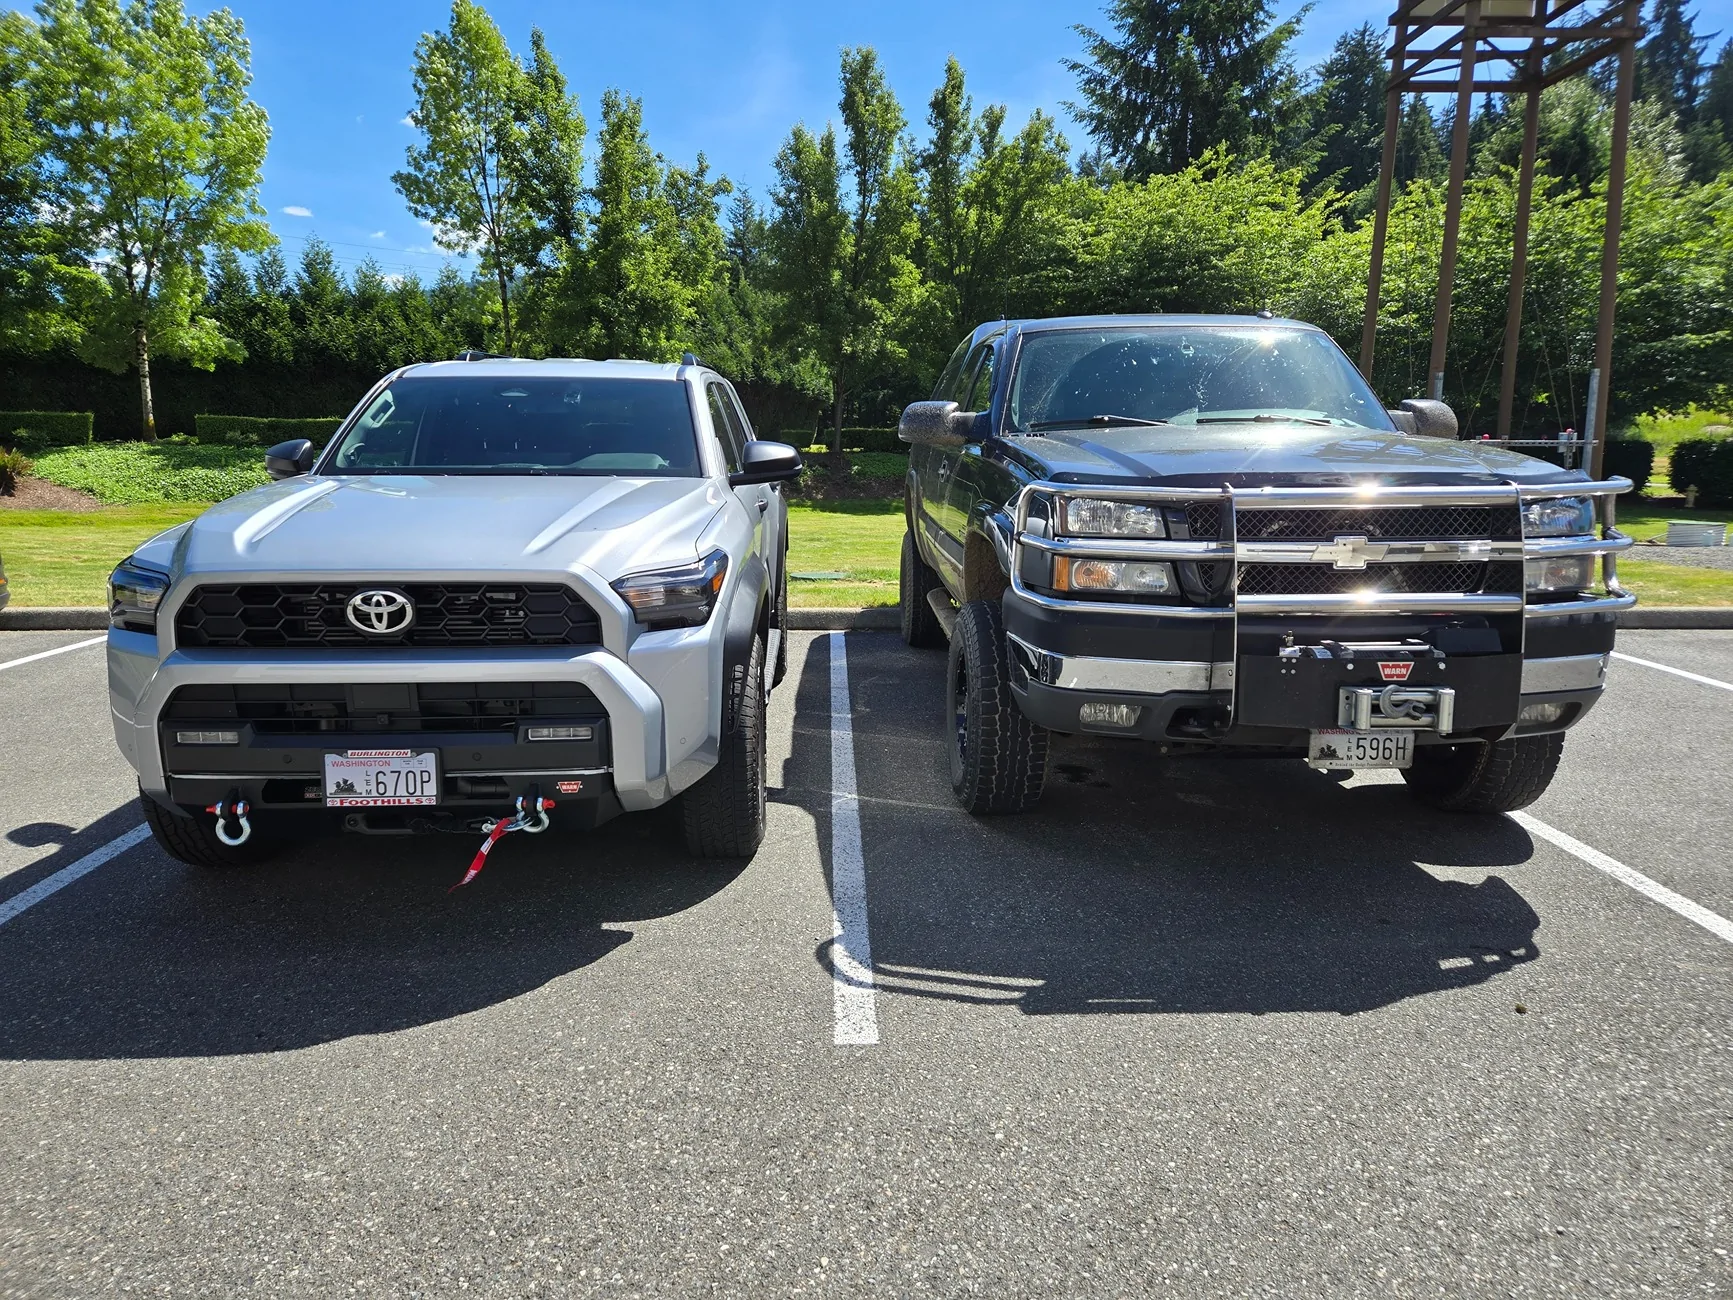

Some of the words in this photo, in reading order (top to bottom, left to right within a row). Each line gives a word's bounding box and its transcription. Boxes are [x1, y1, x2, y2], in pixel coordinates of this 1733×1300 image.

[1384, 667, 1407, 675] WARN
[1356, 737, 1407, 760] 596H
[331, 760, 391, 768] WASHINGTON
[375, 770, 431, 796] 670P
[339, 797, 423, 806] FOOTHILLS
